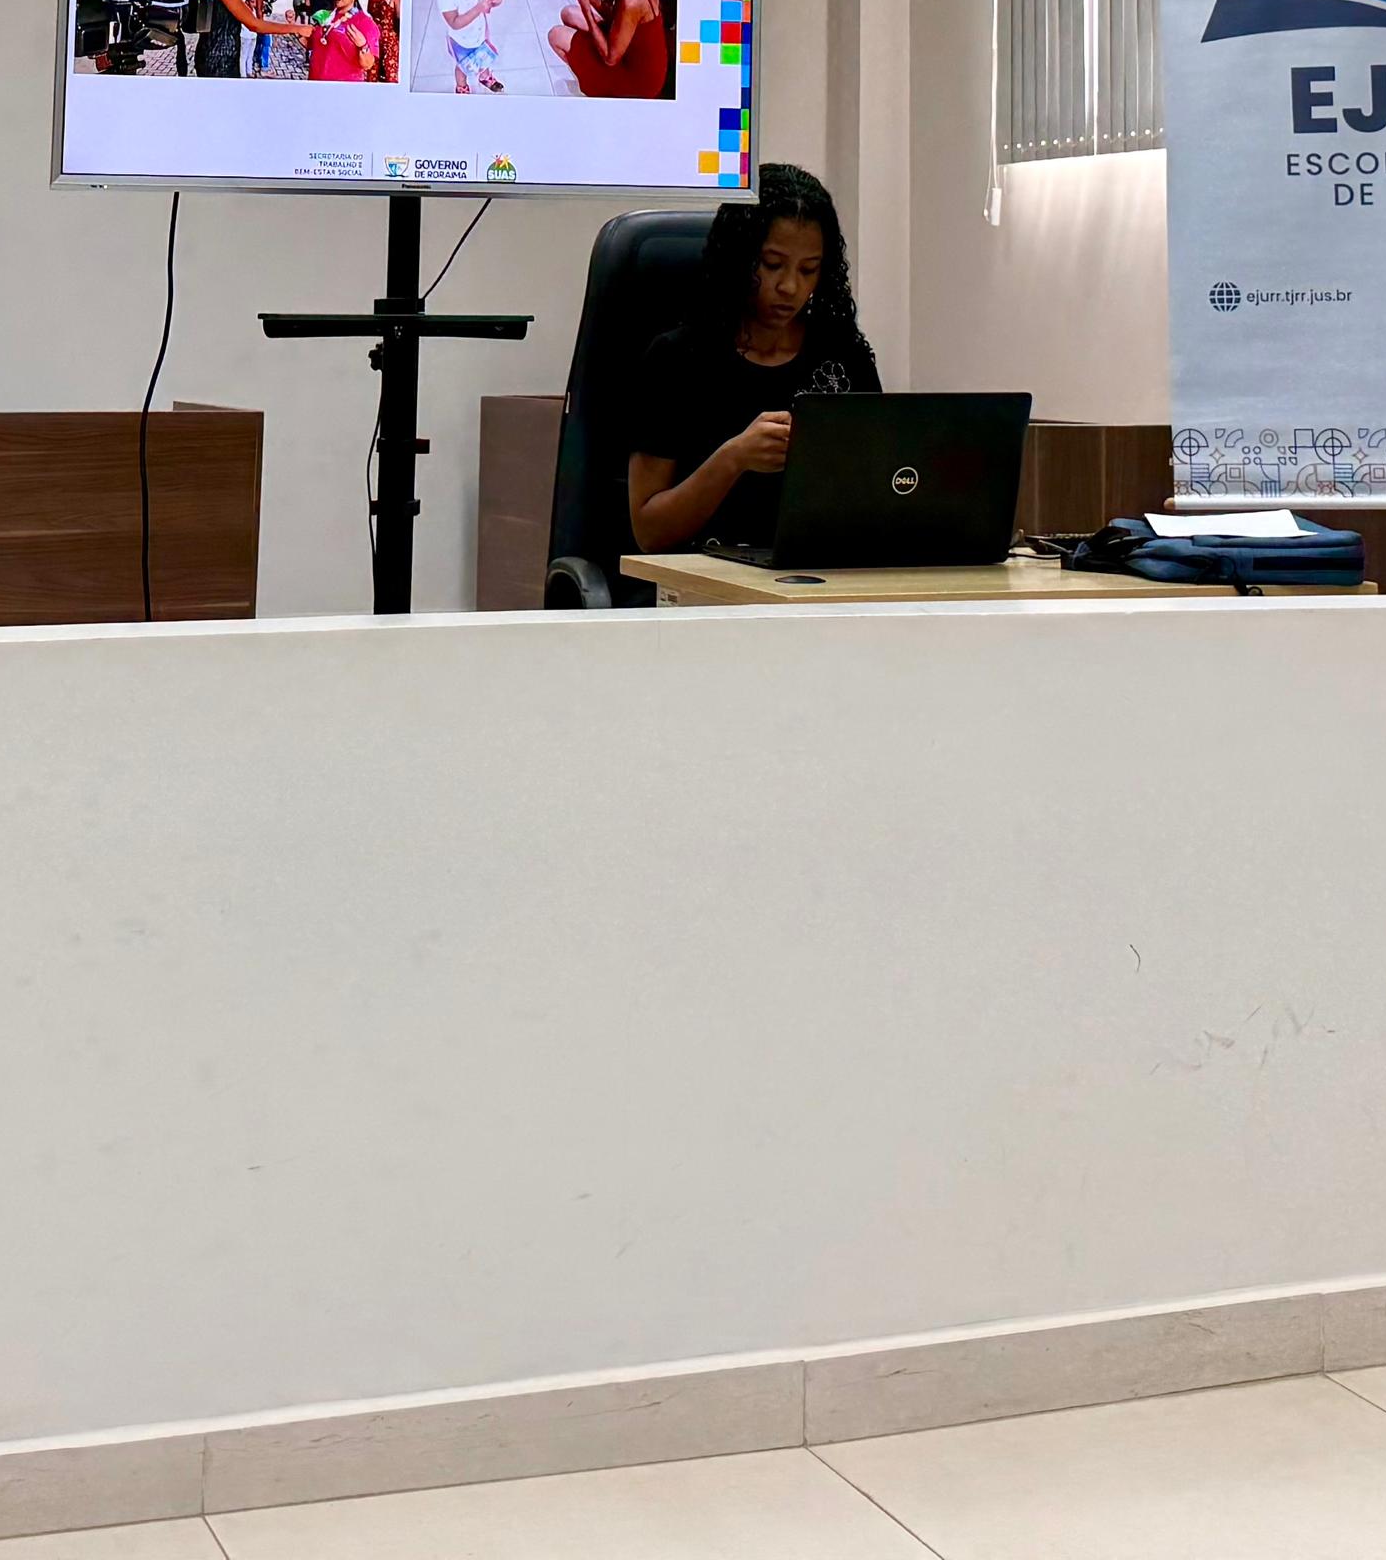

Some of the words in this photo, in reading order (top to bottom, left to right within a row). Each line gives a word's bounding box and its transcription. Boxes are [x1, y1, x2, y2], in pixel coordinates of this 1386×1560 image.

[414, 159, 468, 171] GOVERNO
[414, 170, 425, 179] DE
[427, 170, 467, 179] RORAIMA
[487, 169, 516, 181] SUAS
[1334, 183, 1374, 206] DE
[1246, 289, 1353, 306] ejurr.tjrr.jus.br
